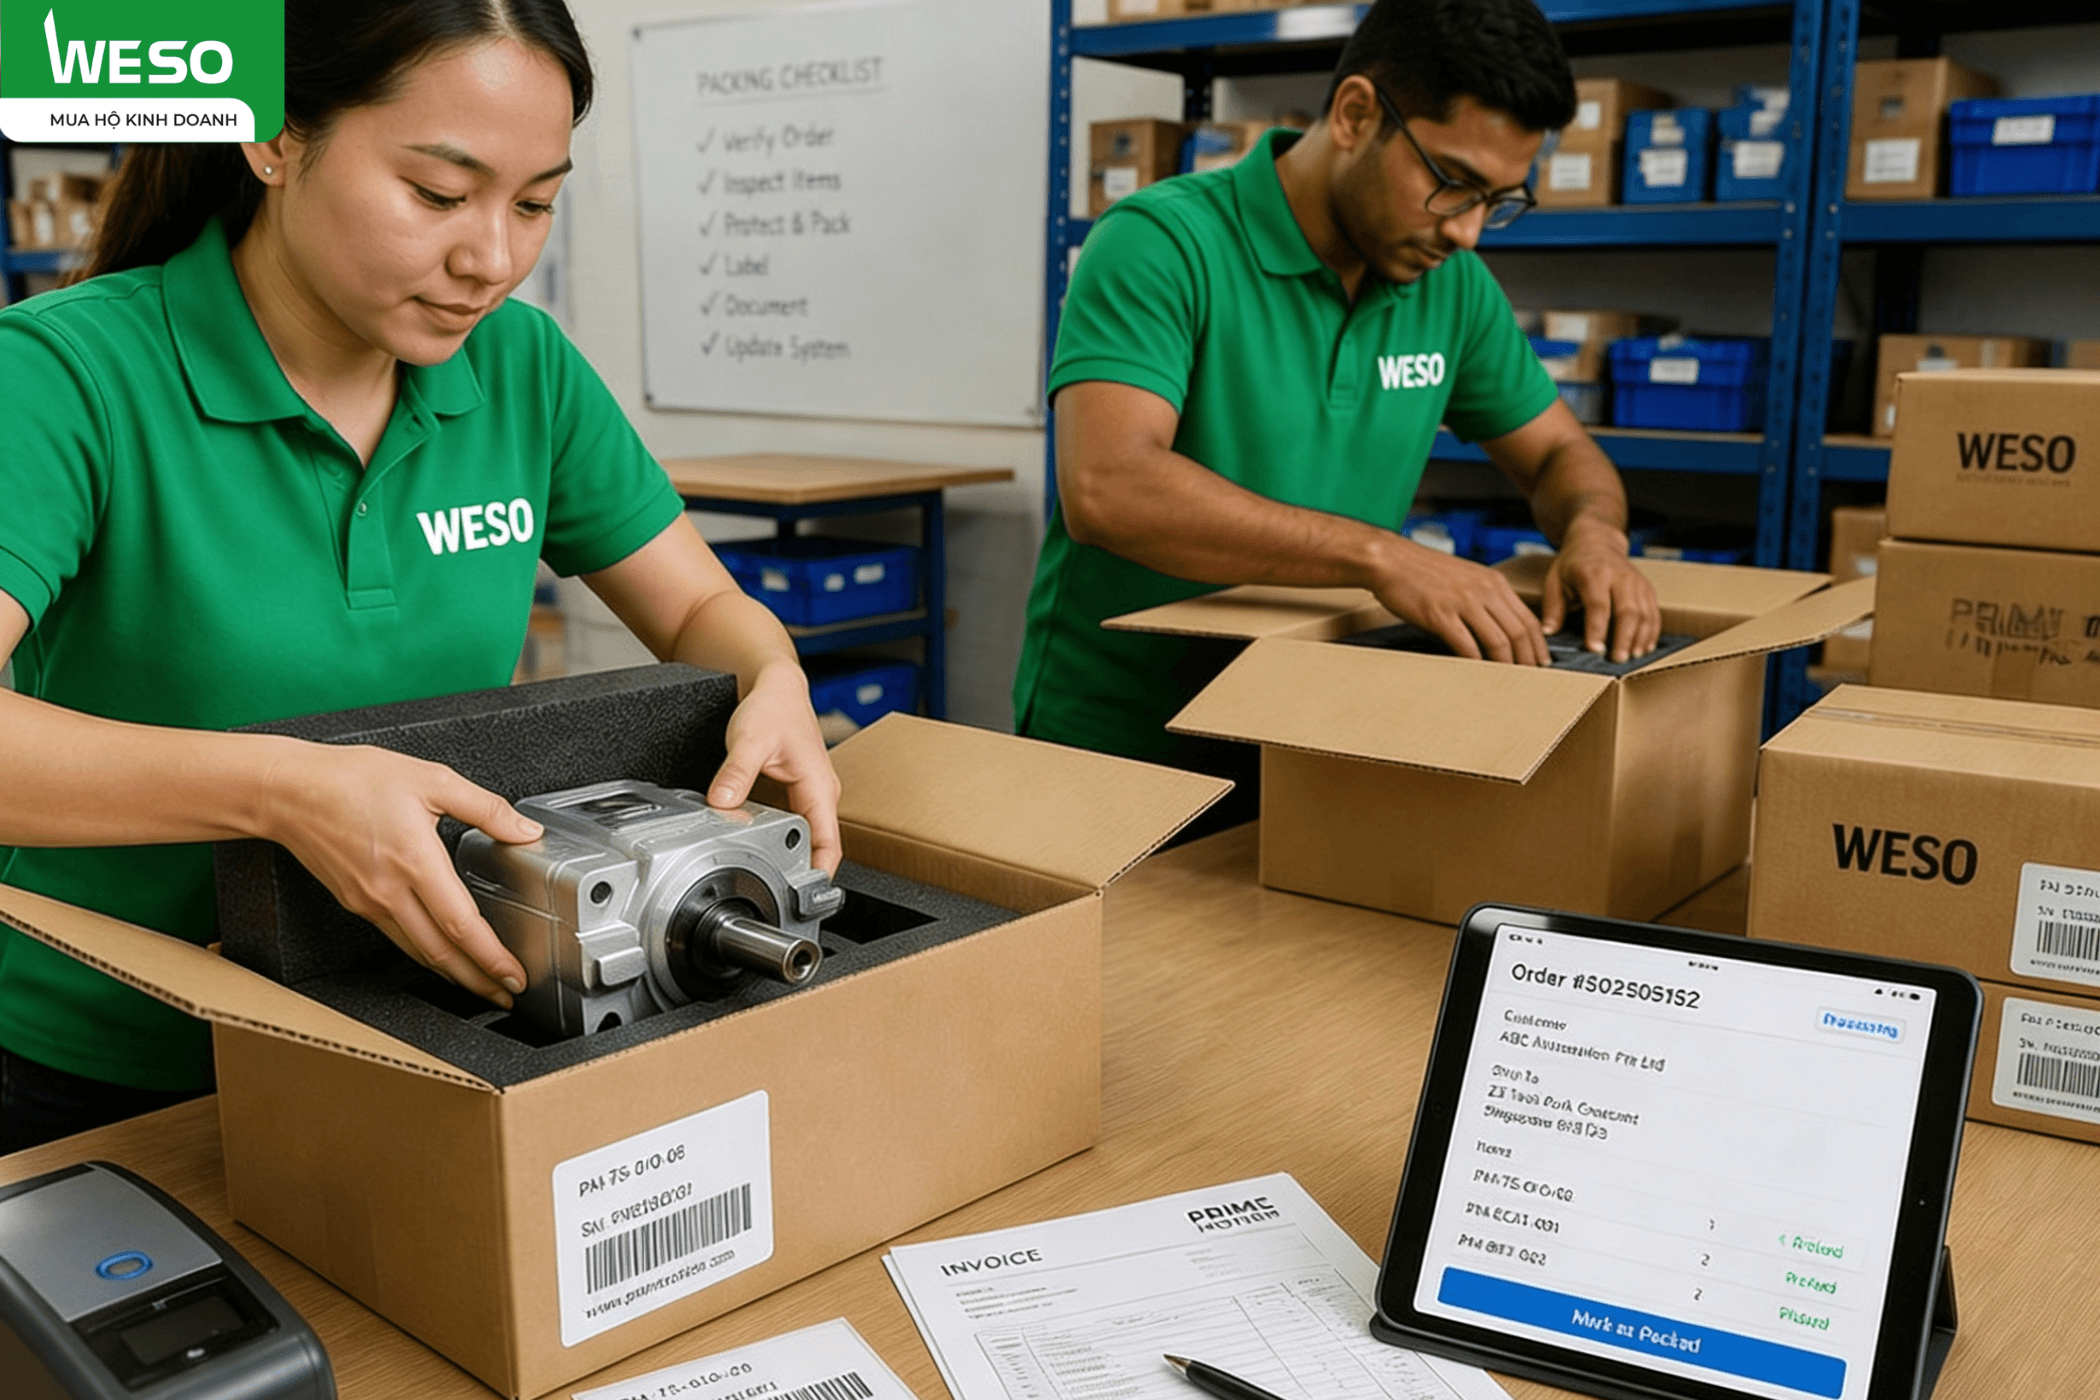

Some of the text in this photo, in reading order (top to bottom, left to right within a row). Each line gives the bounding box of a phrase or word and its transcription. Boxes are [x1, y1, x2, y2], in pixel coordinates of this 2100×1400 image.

[697, 57, 883, 95] PACKING CHECKLIST
[723, 126, 834, 156] Verify Order
[723, 171, 785, 200] Inspect
[724, 212, 785, 236] Protect
[811, 210, 851, 235] Pack
[725, 253, 769, 276] Label
[725, 294, 808, 317] Document
[725, 335, 851, 364] Update System
[1377, 352, 1446, 390] WESO
[1957, 432, 2076, 474] WESO
[415, 497, 535, 556] WESO
[1832, 823, 1979, 887] WESO
[1511, 963, 1567, 989] Order
[940, 1248, 1043, 1277] INVOICE
